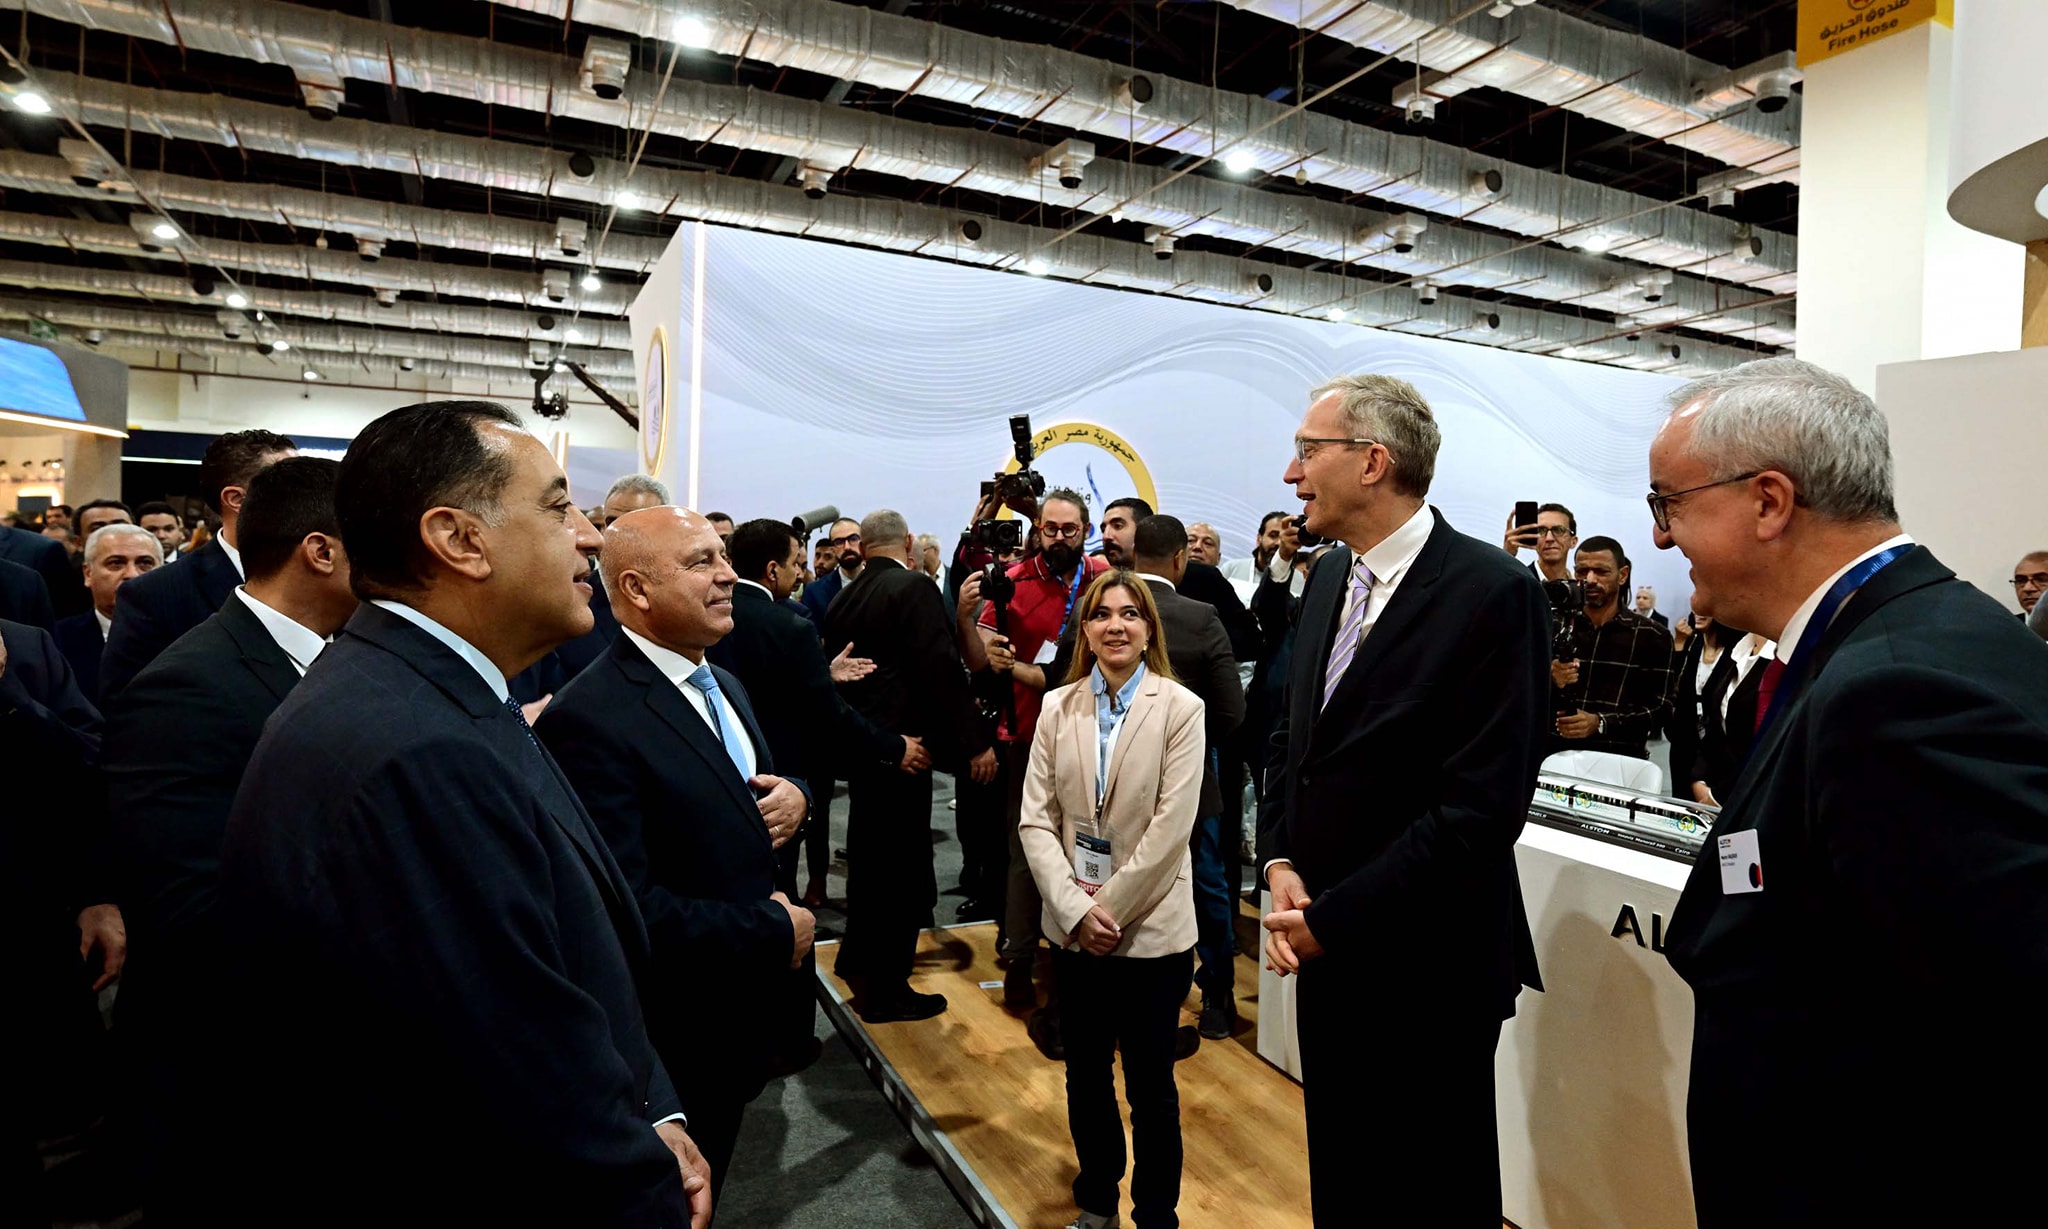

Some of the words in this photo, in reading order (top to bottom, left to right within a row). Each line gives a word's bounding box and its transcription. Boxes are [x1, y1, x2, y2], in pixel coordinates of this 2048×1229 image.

[1829, 35, 1856, 51] Fire
[1860, 18, 1898, 39] Hose
[1032, 429, 1057, 453] العربي
[1064, 429, 1089, 442] مصر
[1094, 429, 1135, 462] جمهورية
[1610, 903, 1667, 955] AL
